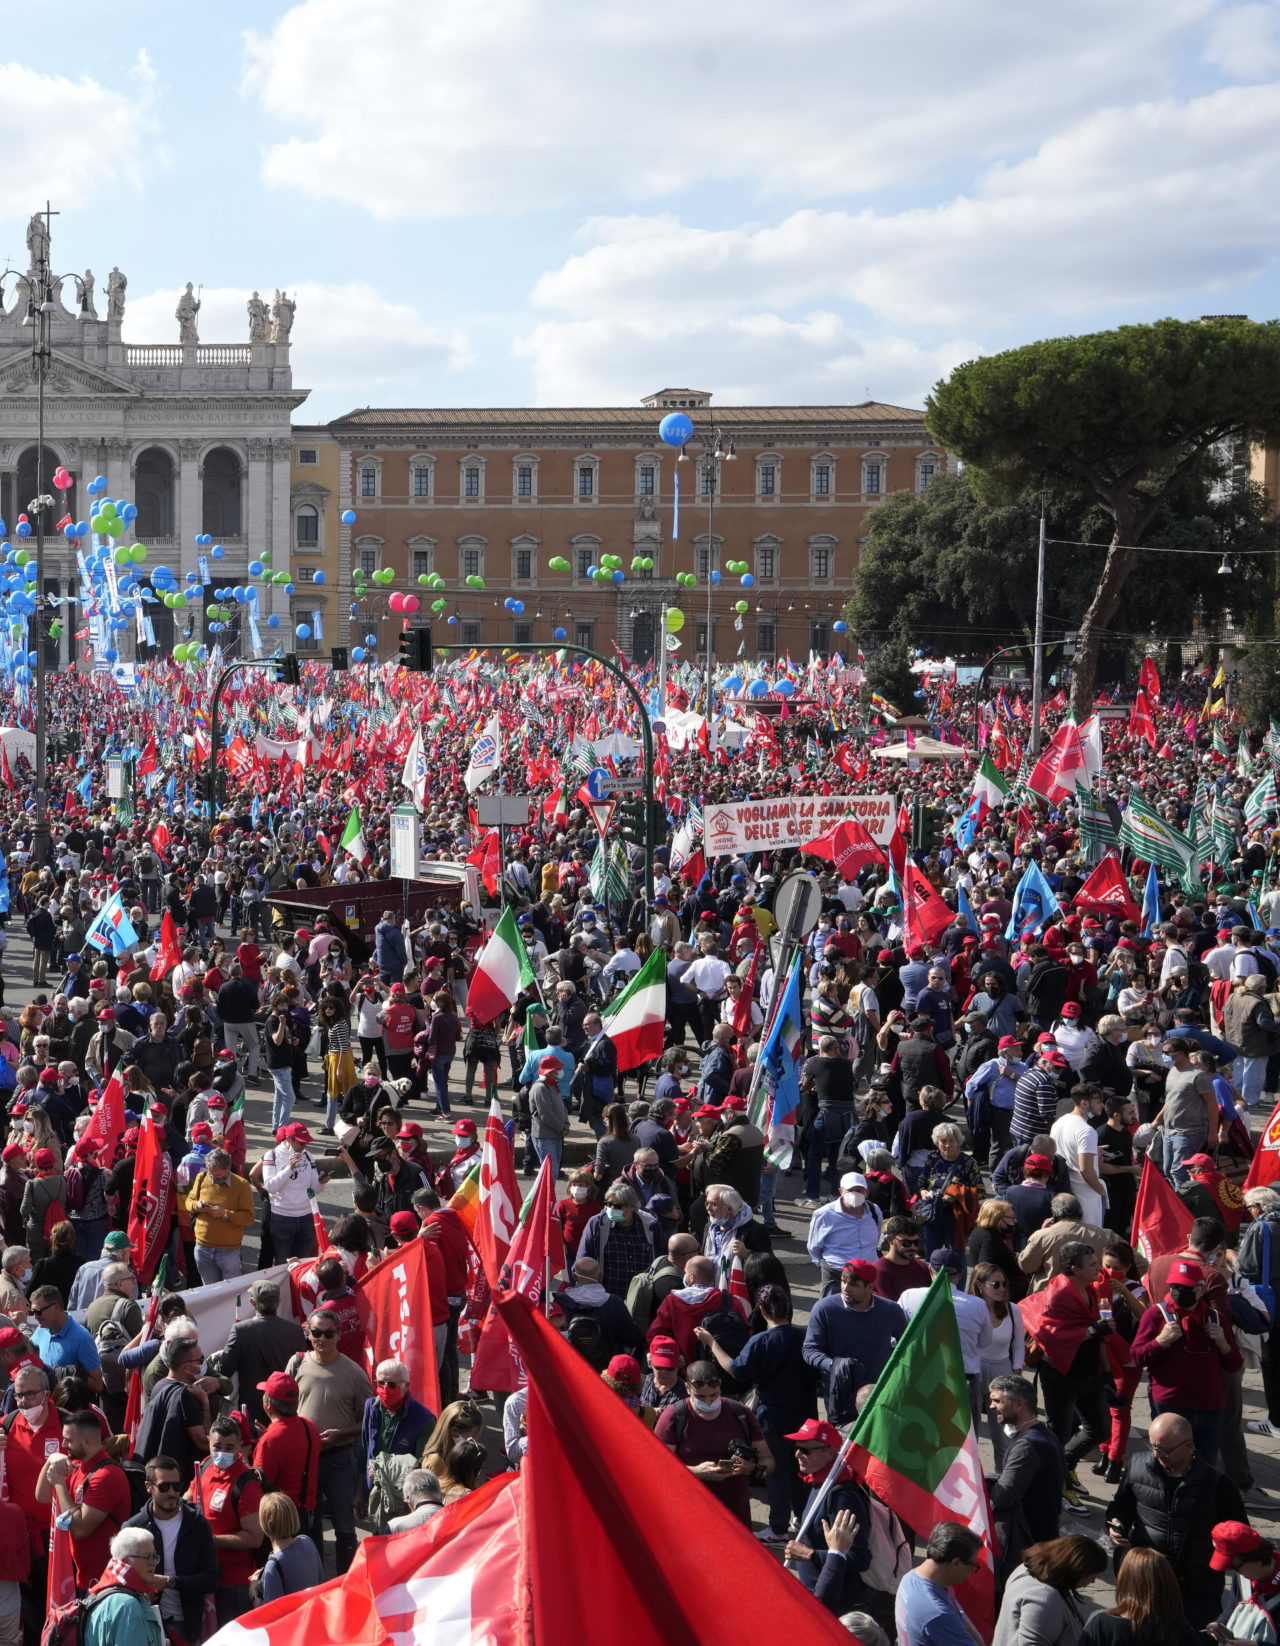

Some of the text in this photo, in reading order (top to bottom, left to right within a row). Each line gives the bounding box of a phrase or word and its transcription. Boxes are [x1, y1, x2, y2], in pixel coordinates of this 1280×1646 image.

[800, 802, 815, 818] LA
[817, 800, 890, 818] SANATORIA
[744, 821, 780, 841] DELLE
[913, 879, 931, 902] CGIL
